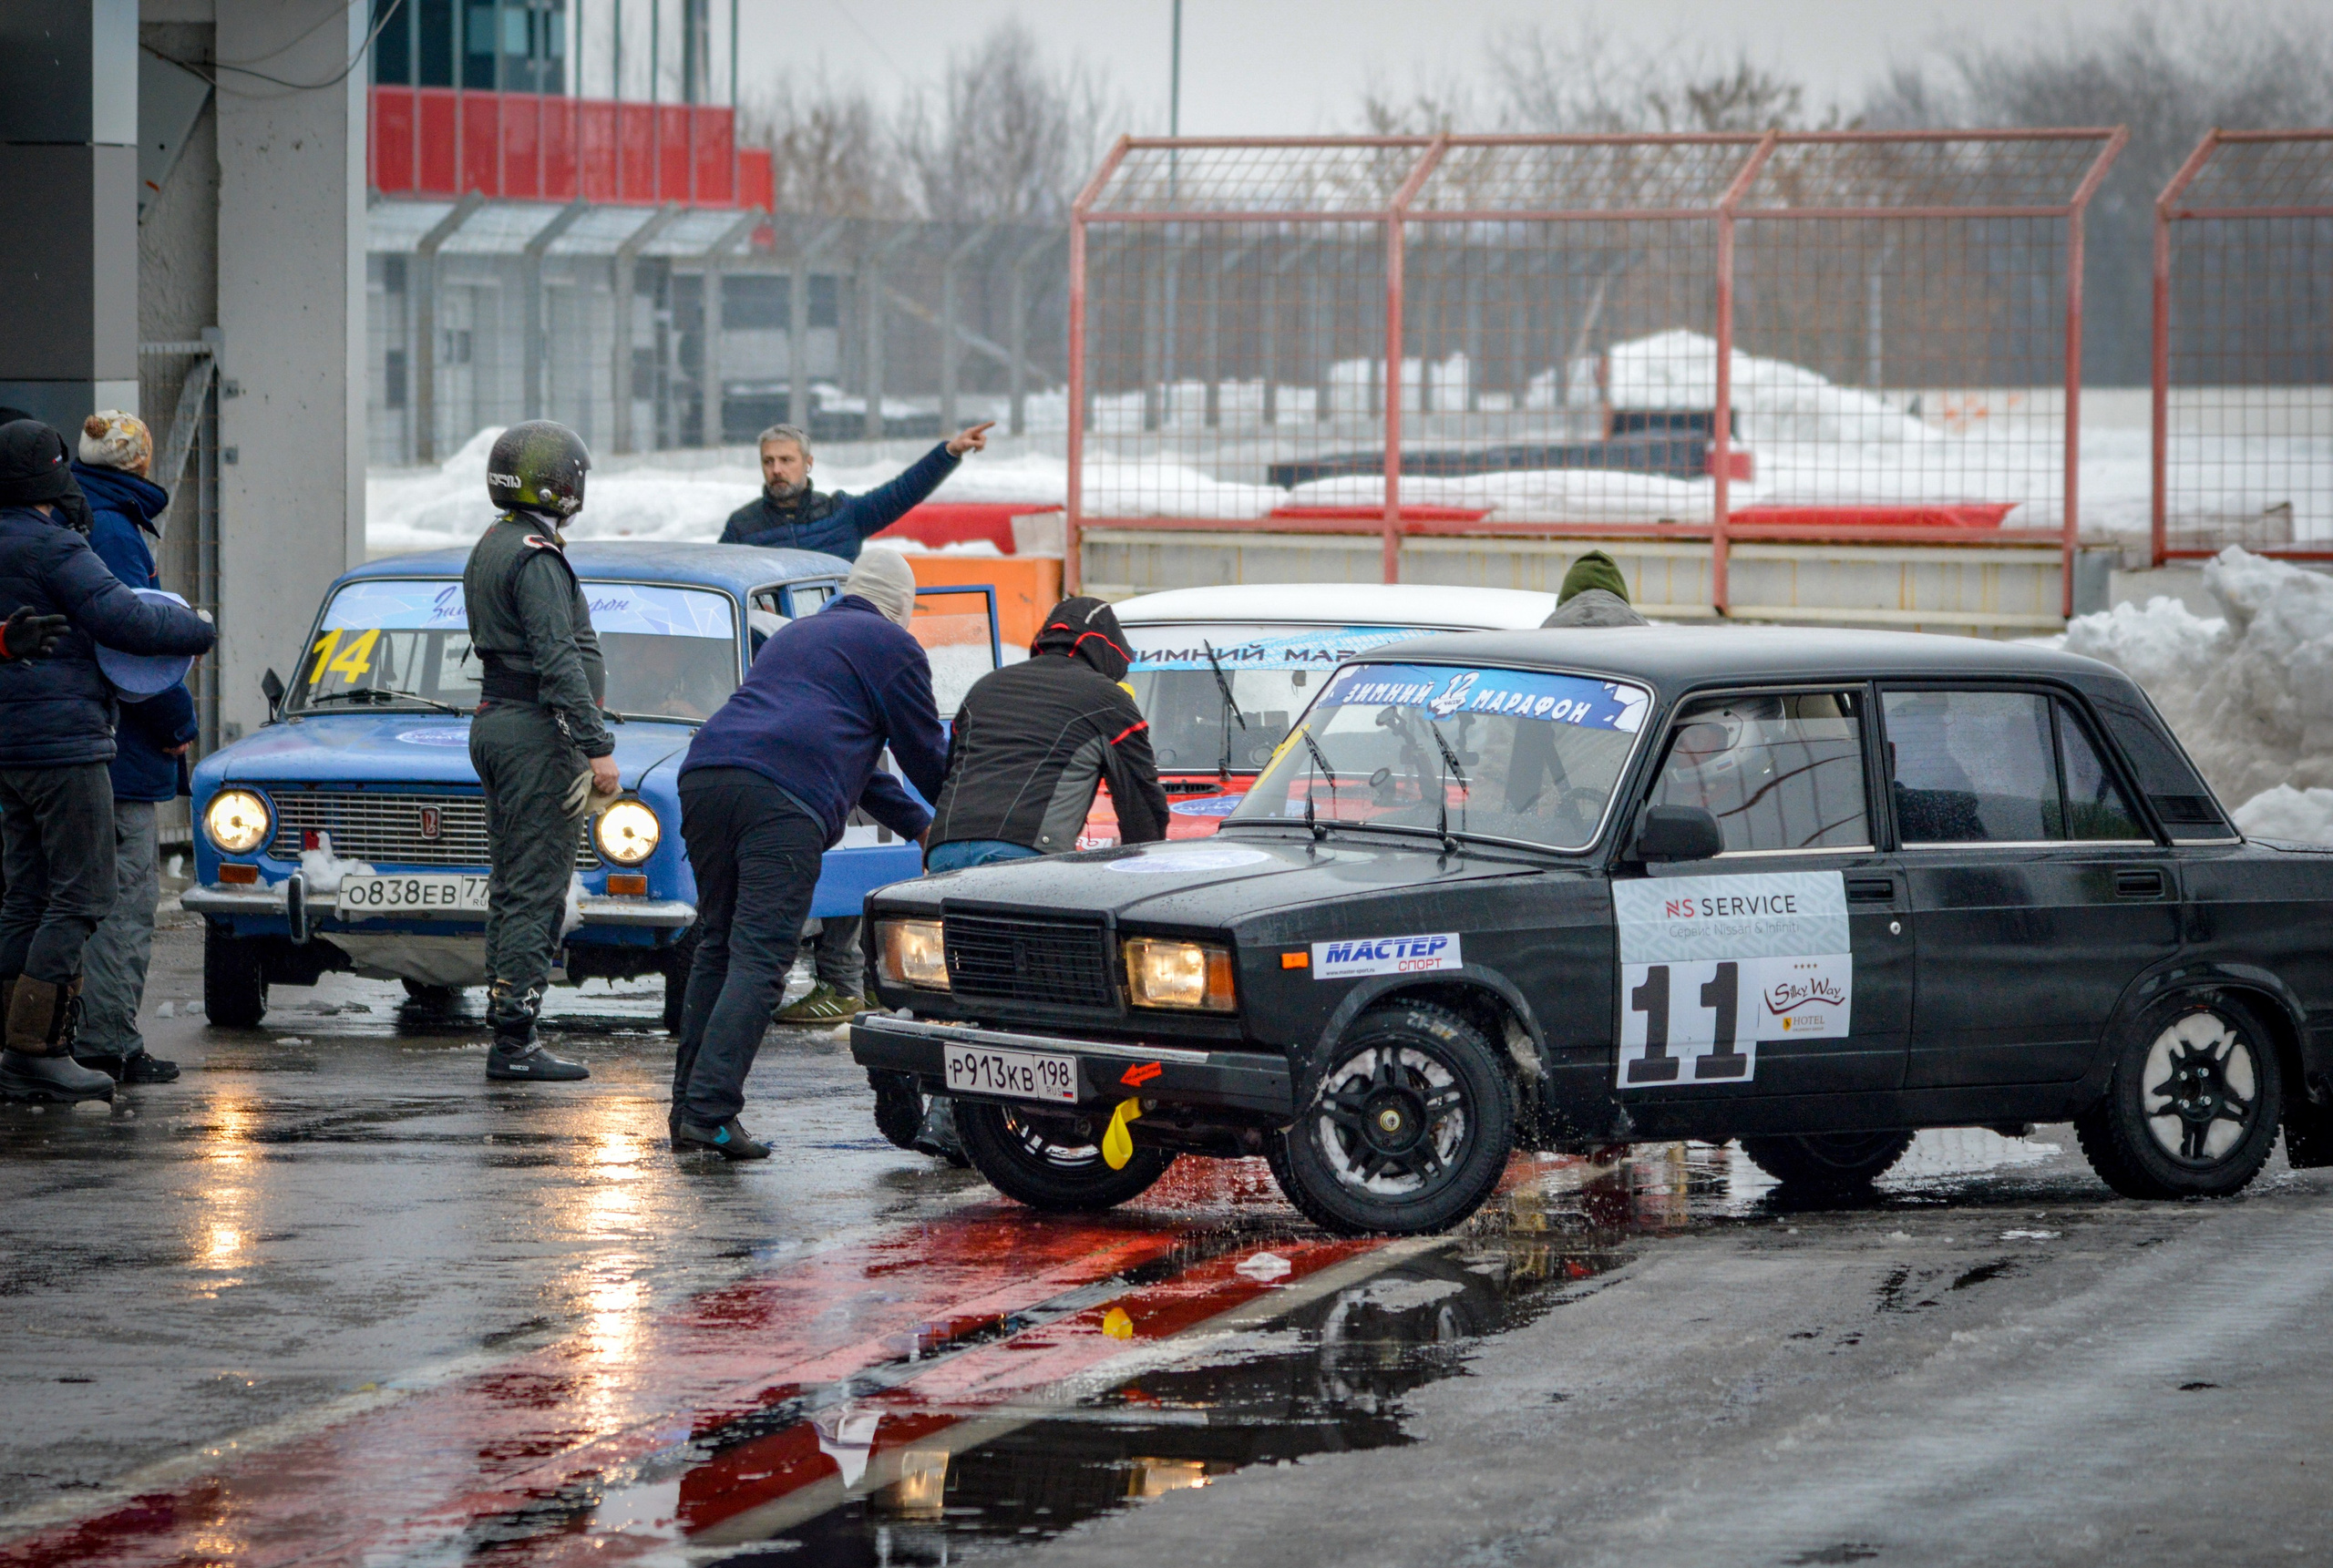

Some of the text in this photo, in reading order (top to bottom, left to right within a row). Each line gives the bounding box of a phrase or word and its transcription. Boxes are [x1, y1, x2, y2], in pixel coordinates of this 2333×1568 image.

[310, 627, 381, 684] 14
[1342, 671, 1592, 724] ЗИМНИЙ 12 МАРАФОН
[1665, 895, 1797, 918] NS SERVICE
[1669, 921, 1800, 938] Сервис Nissan & Infiniti
[1325, 936, 1448, 964] МАСТЕР
[1398, 958, 1443, 971] СПОРТ
[1774, 977, 1841, 1006] Silky Way
[1627, 961, 1747, 1083] 11
[1793, 1015, 1825, 1026] HOTEL
[1037, 1060, 1070, 1087] 198
[1047, 1087, 1064, 1097] RUS
